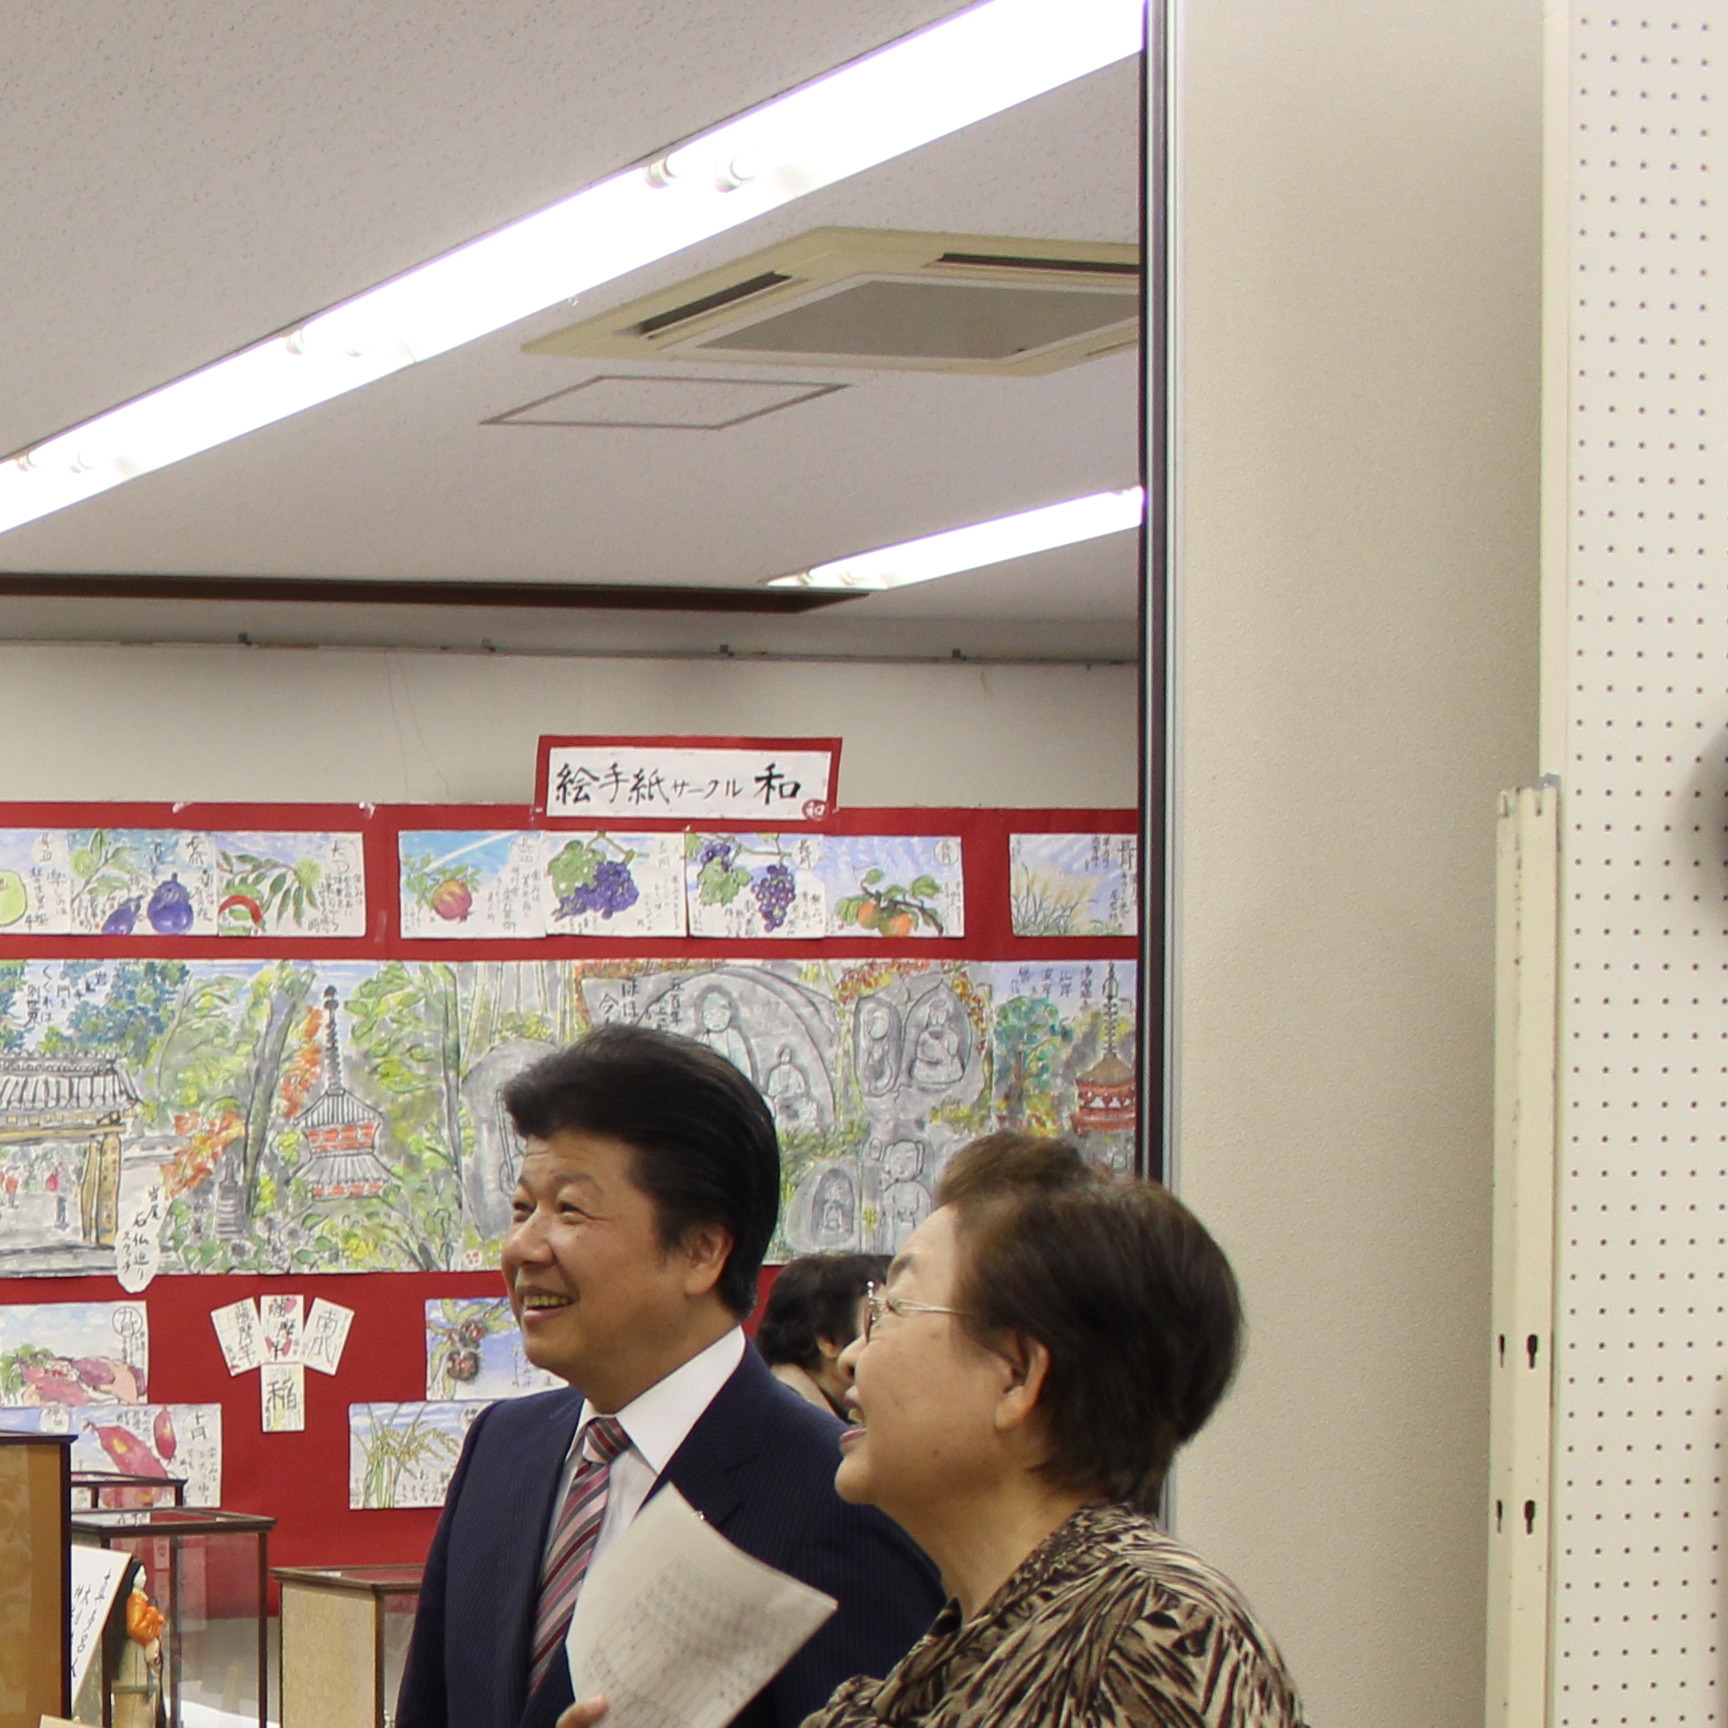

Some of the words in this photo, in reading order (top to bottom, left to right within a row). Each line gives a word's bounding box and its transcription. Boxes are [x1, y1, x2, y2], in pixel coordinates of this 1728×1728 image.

[554, 763, 744, 805] 絵手紙サークル
[753, 762, 801, 806] 和
[267, 1377, 297, 1411] 稲
